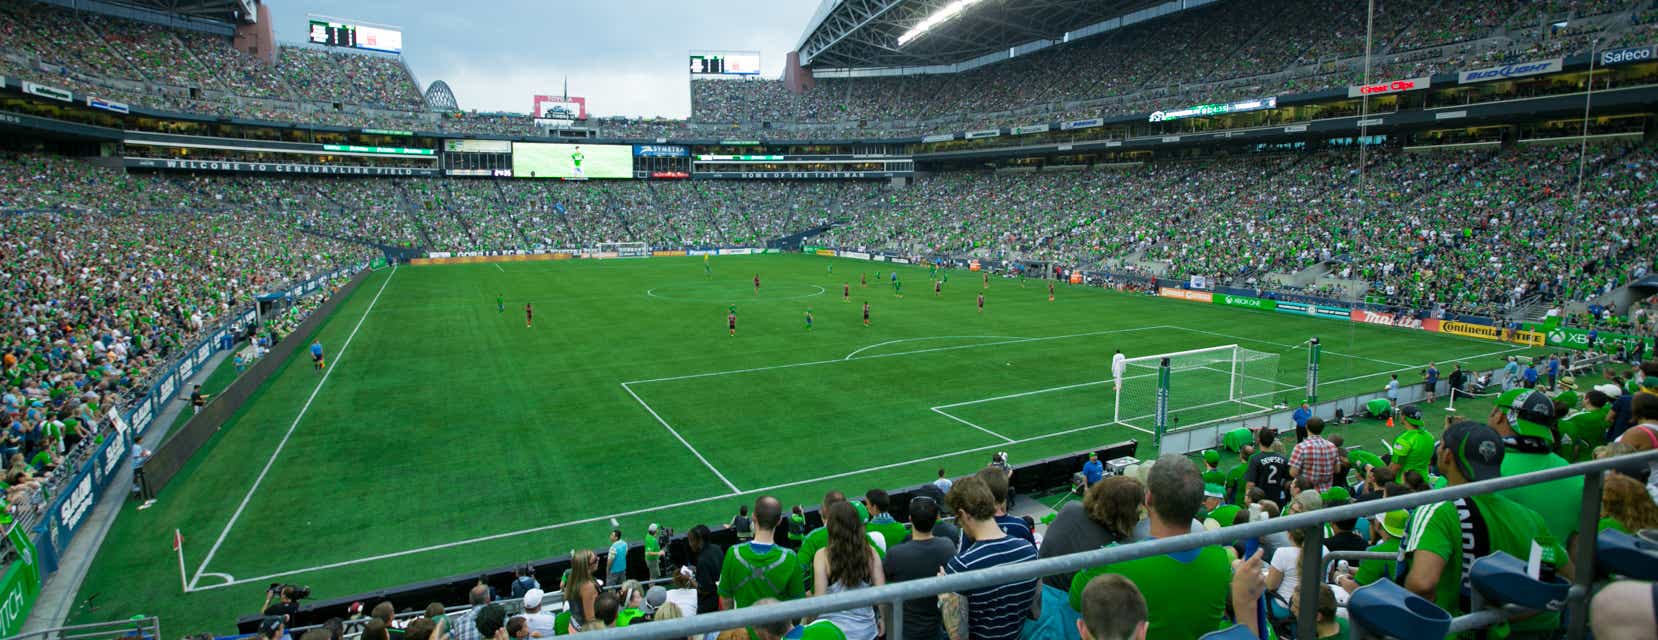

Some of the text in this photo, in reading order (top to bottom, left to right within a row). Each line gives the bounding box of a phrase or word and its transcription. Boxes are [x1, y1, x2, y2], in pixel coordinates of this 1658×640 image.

[1603, 49, 1650, 65] Safeco
[1465, 62, 1553, 81] BUD LIGHT
[167, 161, 240, 170] WELCOME
[276, 165, 369, 174] CENTURYLINK
[1443, 322, 1499, 337] Continenta
[1568, 333, 1606, 345] XBX
[1267, 464, 1277, 484] 2
